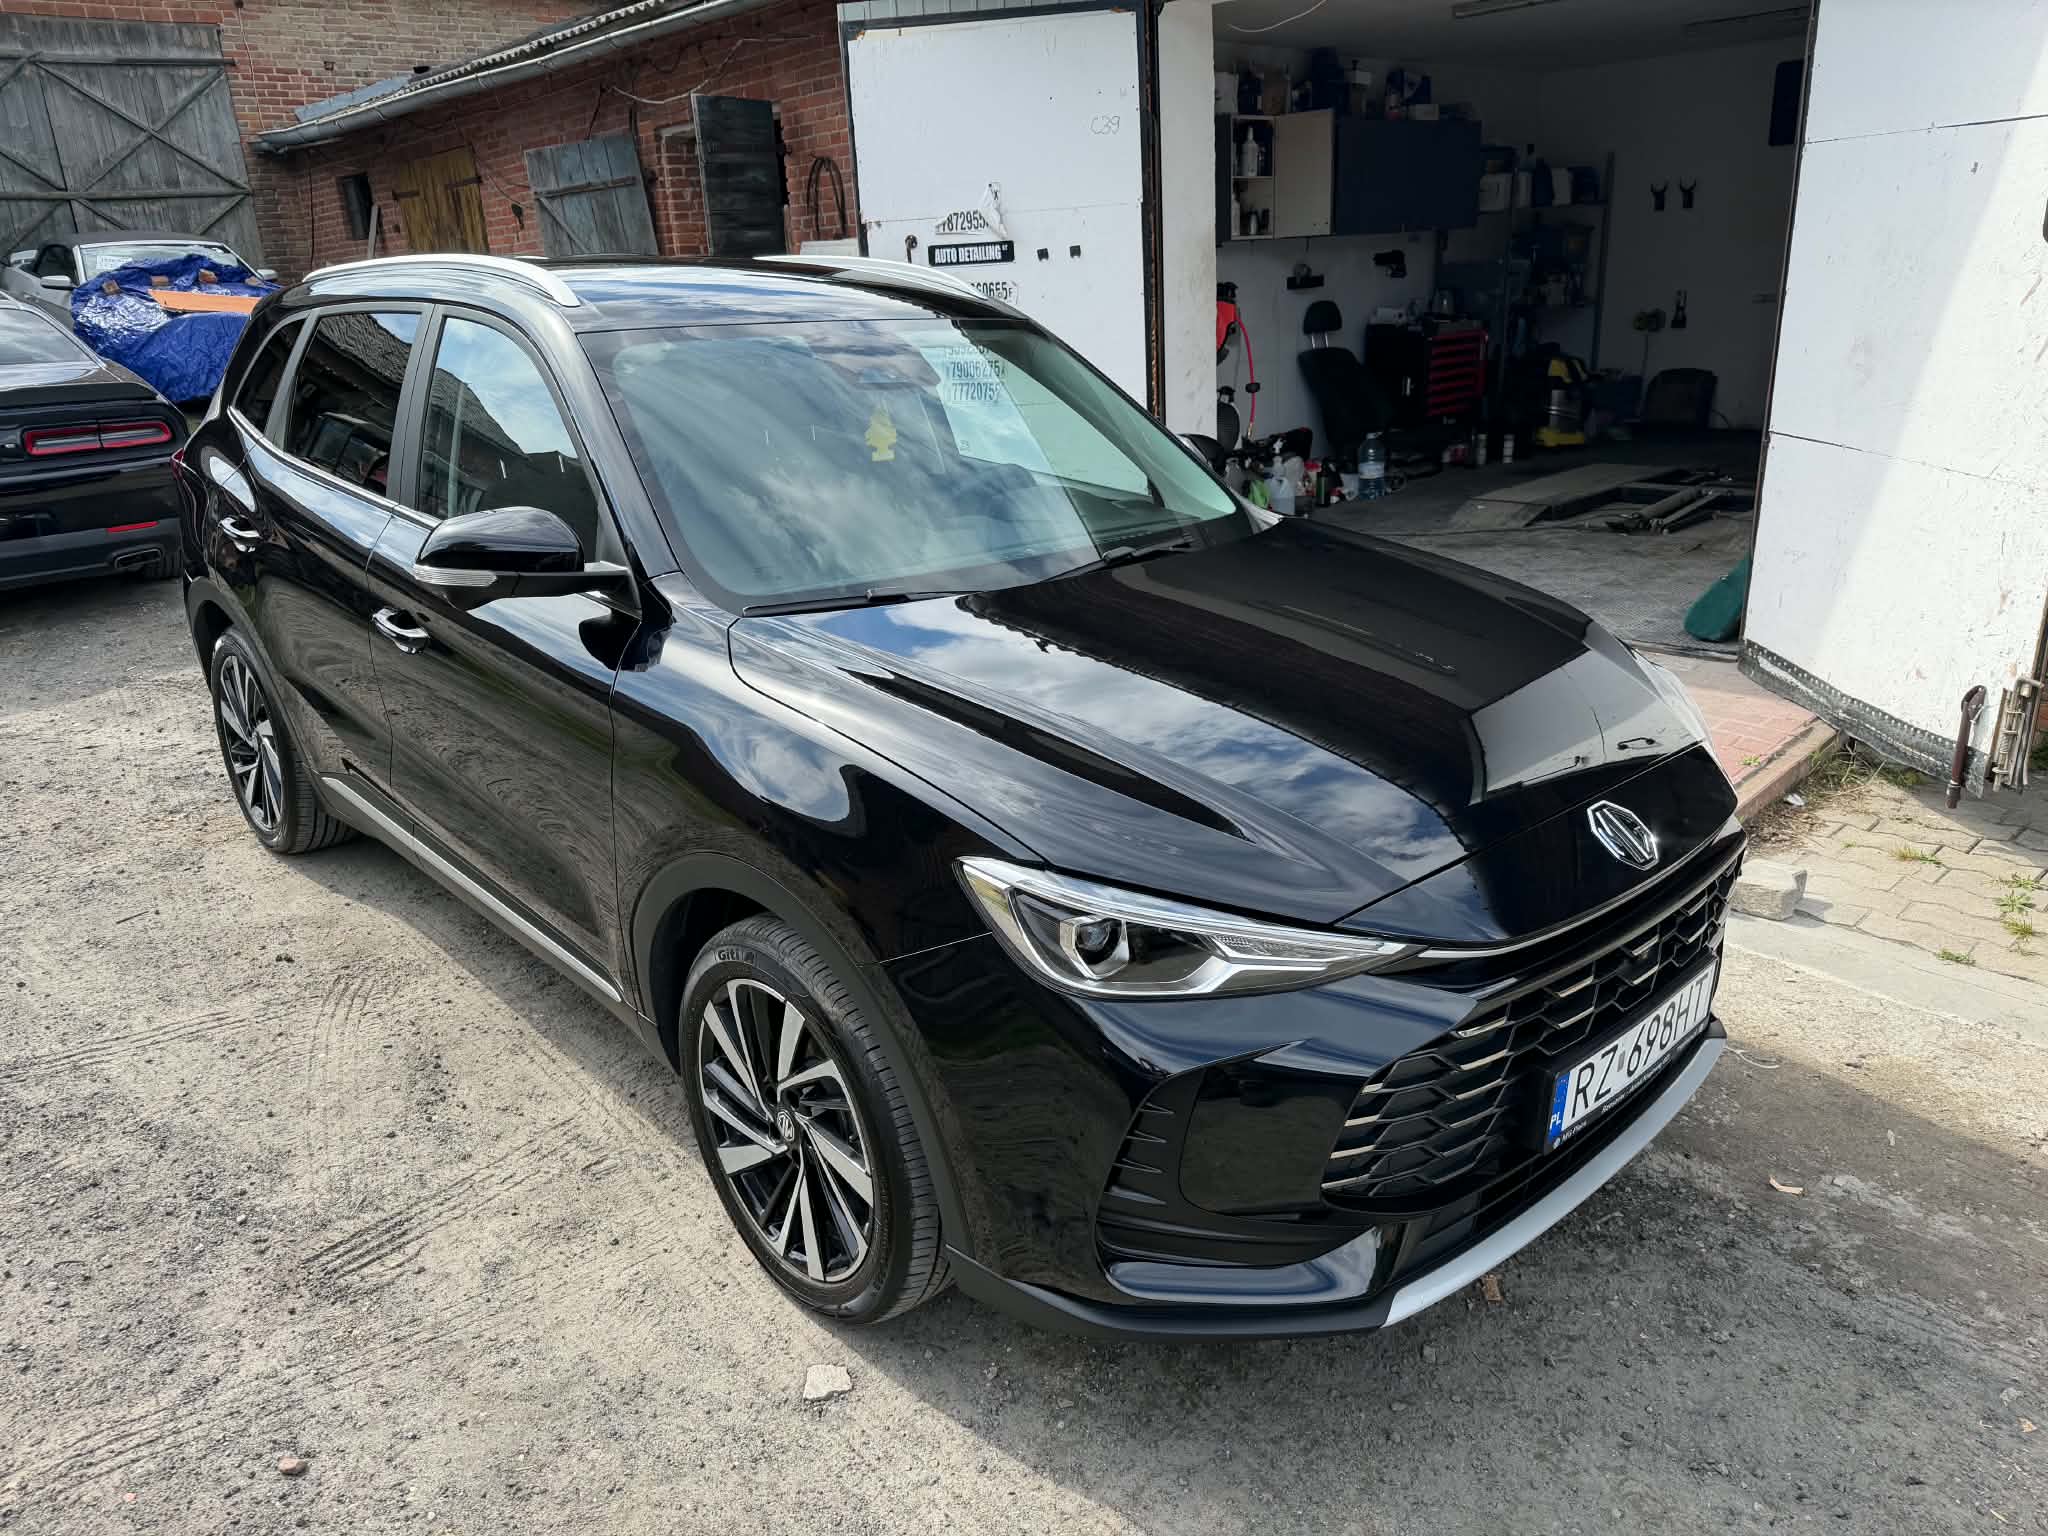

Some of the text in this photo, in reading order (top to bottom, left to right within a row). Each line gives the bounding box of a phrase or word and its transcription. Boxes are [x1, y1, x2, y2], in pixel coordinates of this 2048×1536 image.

[934, 243, 1002, 263] AUTO DETAILING
[1571, 1044, 1618, 1119] RZ
[1627, 973, 1709, 1077] 698HT
[1549, 1111, 1562, 1129] PL
